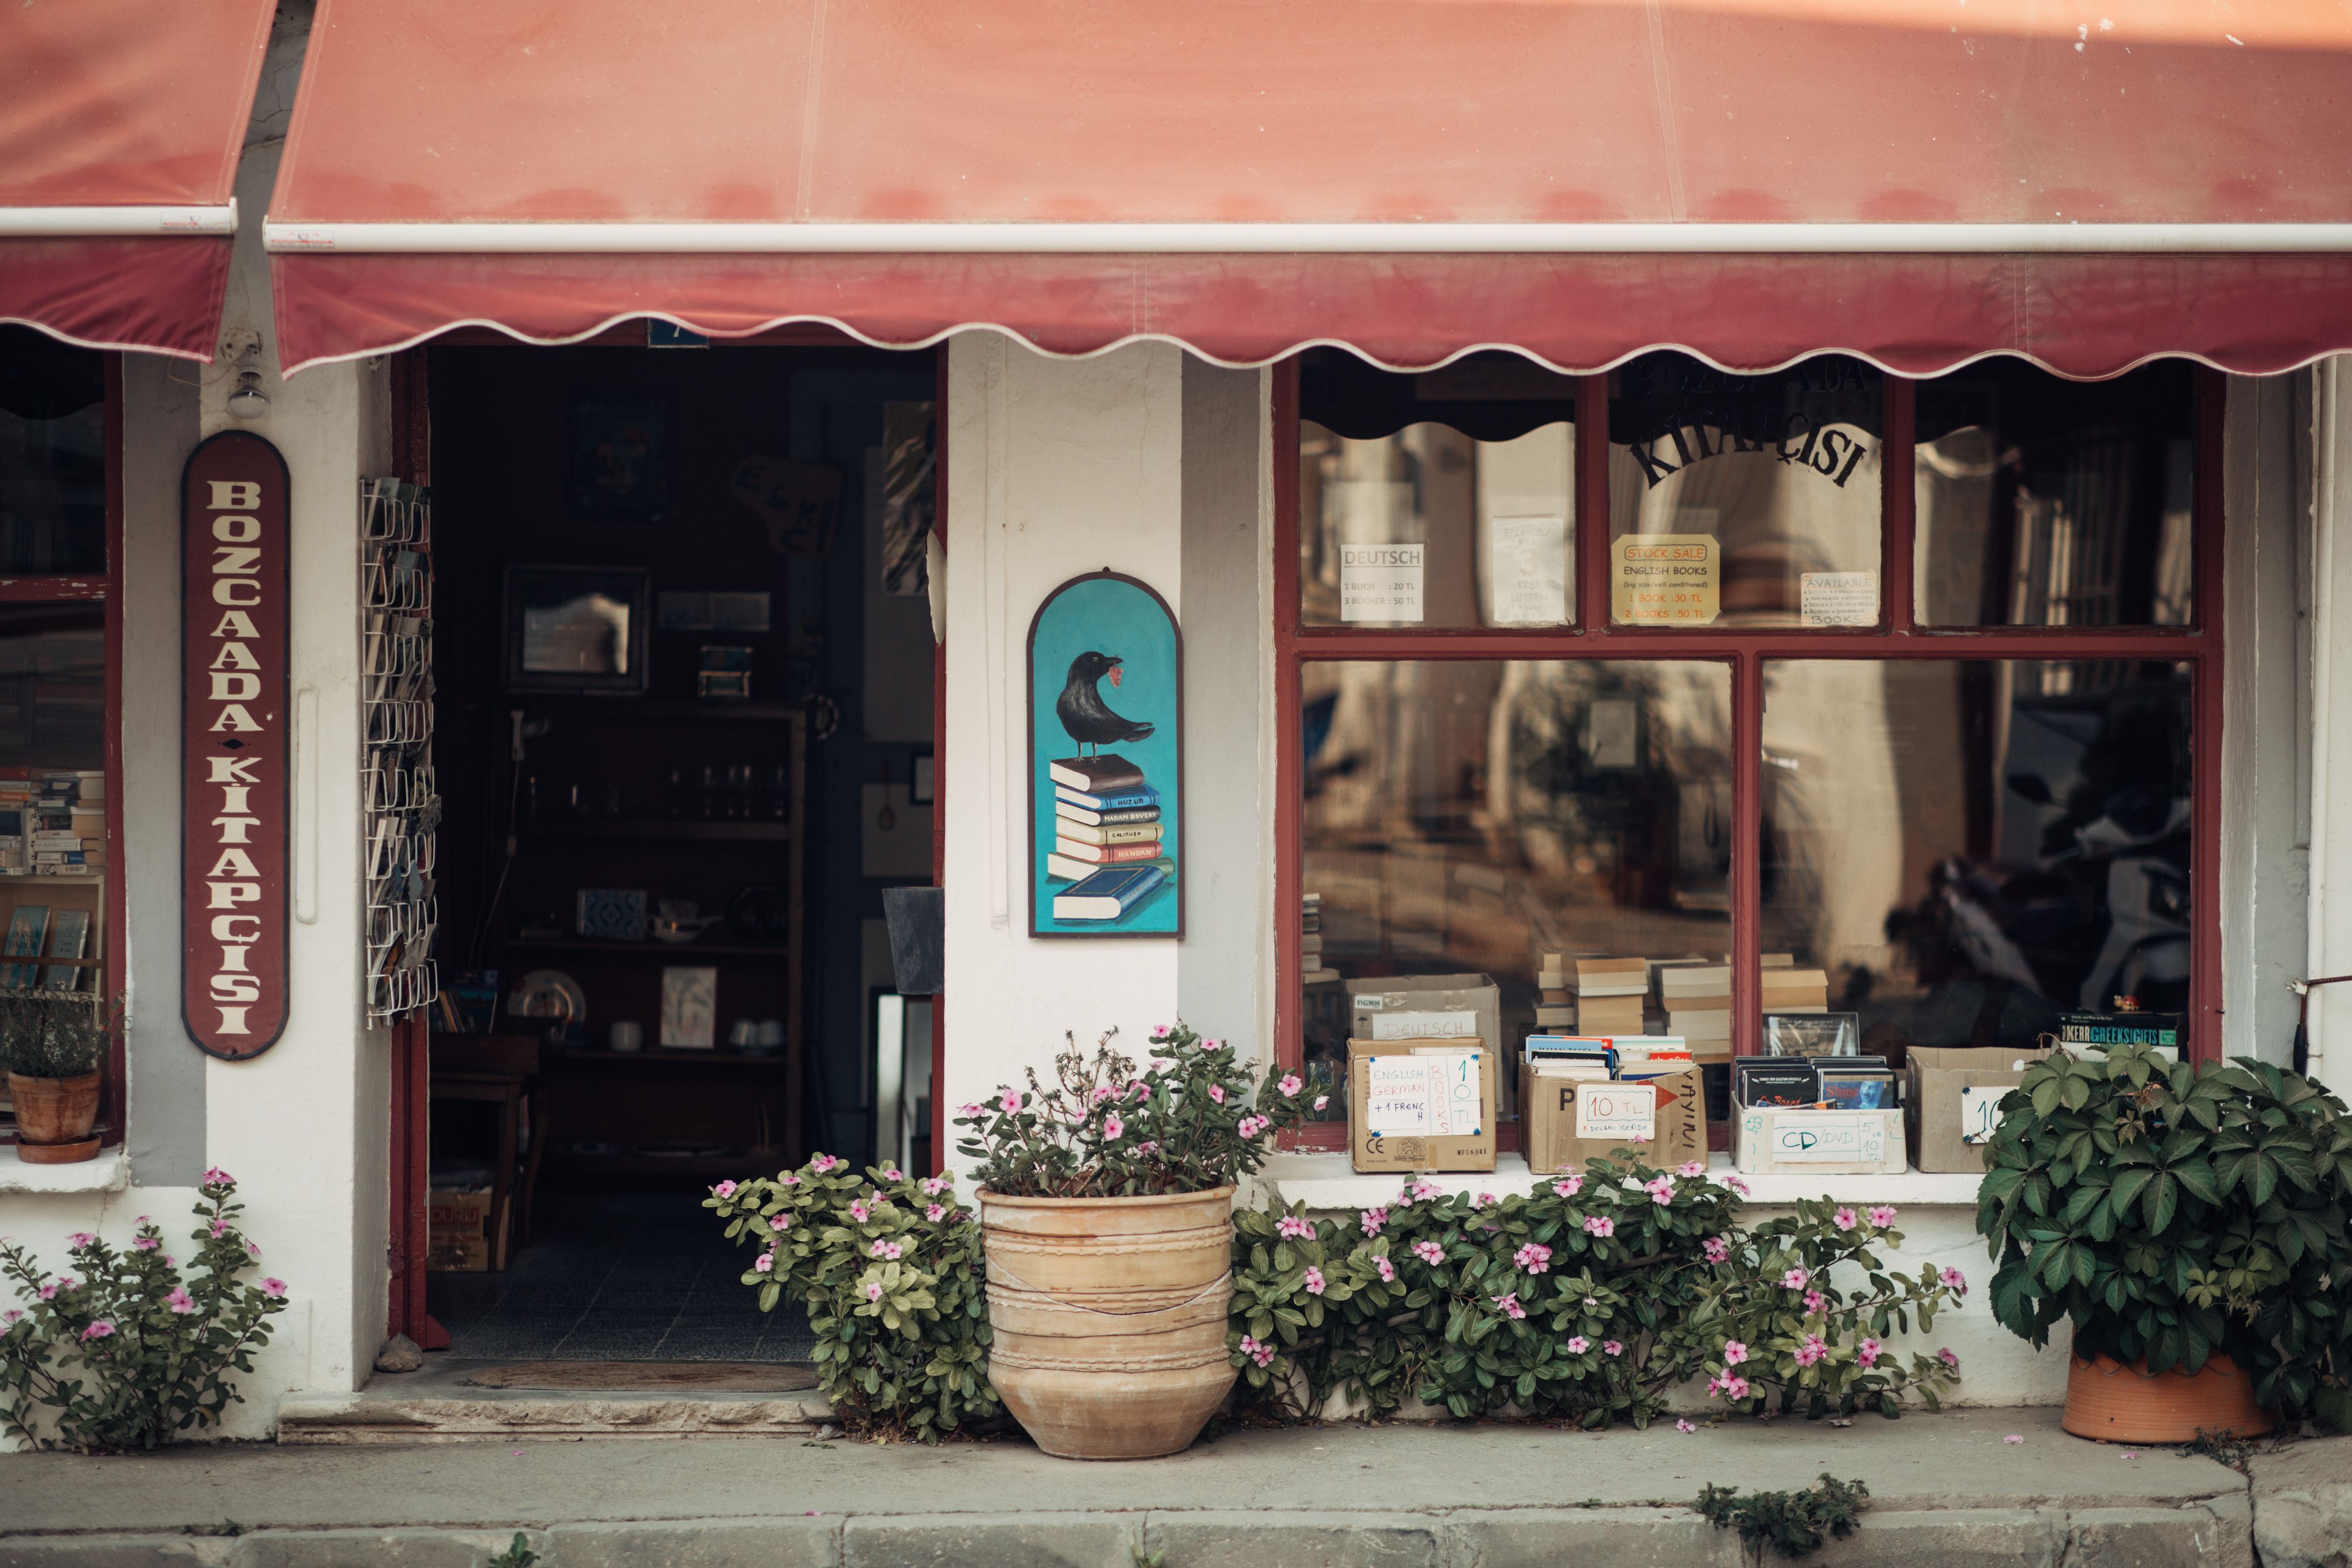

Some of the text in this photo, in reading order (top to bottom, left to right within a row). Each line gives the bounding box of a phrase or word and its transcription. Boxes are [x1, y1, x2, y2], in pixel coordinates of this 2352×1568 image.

[1345, 550, 1420, 564] DEUTSCH
[1627, 548, 1704, 559] STOCK SALE
[1520, 547, 1538, 576] 3
[1623, 566, 1708, 575] ENGLISH BOOKS
[1806, 579, 1873, 588] AVAILABLE
[1351, 595, 1385, 605] BÜCHER
[1629, 594, 1633, 602] 1
[1639, 594, 1666, 603] BOOK
[1690, 594, 1703, 603] TL
[1625, 610, 1631, 618] 2
[1635, 610, 1669, 618] BOOKS
[1693, 610, 1705, 618] TL
[1812, 616, 1862, 624] BOOKS
[205, 480, 265, 1035] BOZCAADA KİTAPÇISI
[1117, 798, 1144, 806] HUZUR
[1130, 811, 1157, 820] BOVERY
[1118, 849, 1152, 858] HANDAN
[1383, 1021, 1463, 1035] DEUTSCH
[2066, 1025, 2090, 1042] KERR
[2090, 1027, 2129, 1045] GREEKS
[2133, 1029, 2157, 1045] GIFTS
[1373, 1070, 1424, 1080] ENGLISH
[1373, 1082, 1425, 1096] GERMAN
[1826, 1085, 1859, 1097] Shine
[1430, 1065, 1449, 1134] BOOKS
[1385, 1102, 1390, 1111] 1
[1394, 1102, 1425, 1111] FRENC
[1591, 1096, 1643, 1116] 10 TL
[1418, 1111, 1423, 1121] H
[1454, 1109, 1475, 1123] TL
[1862, 1122, 1875, 1132] 5
[1782, 1128, 1854, 1150] CD/DVD
[1366, 1138, 1384, 1154] CE
[1863, 1141, 1879, 1152] 10
